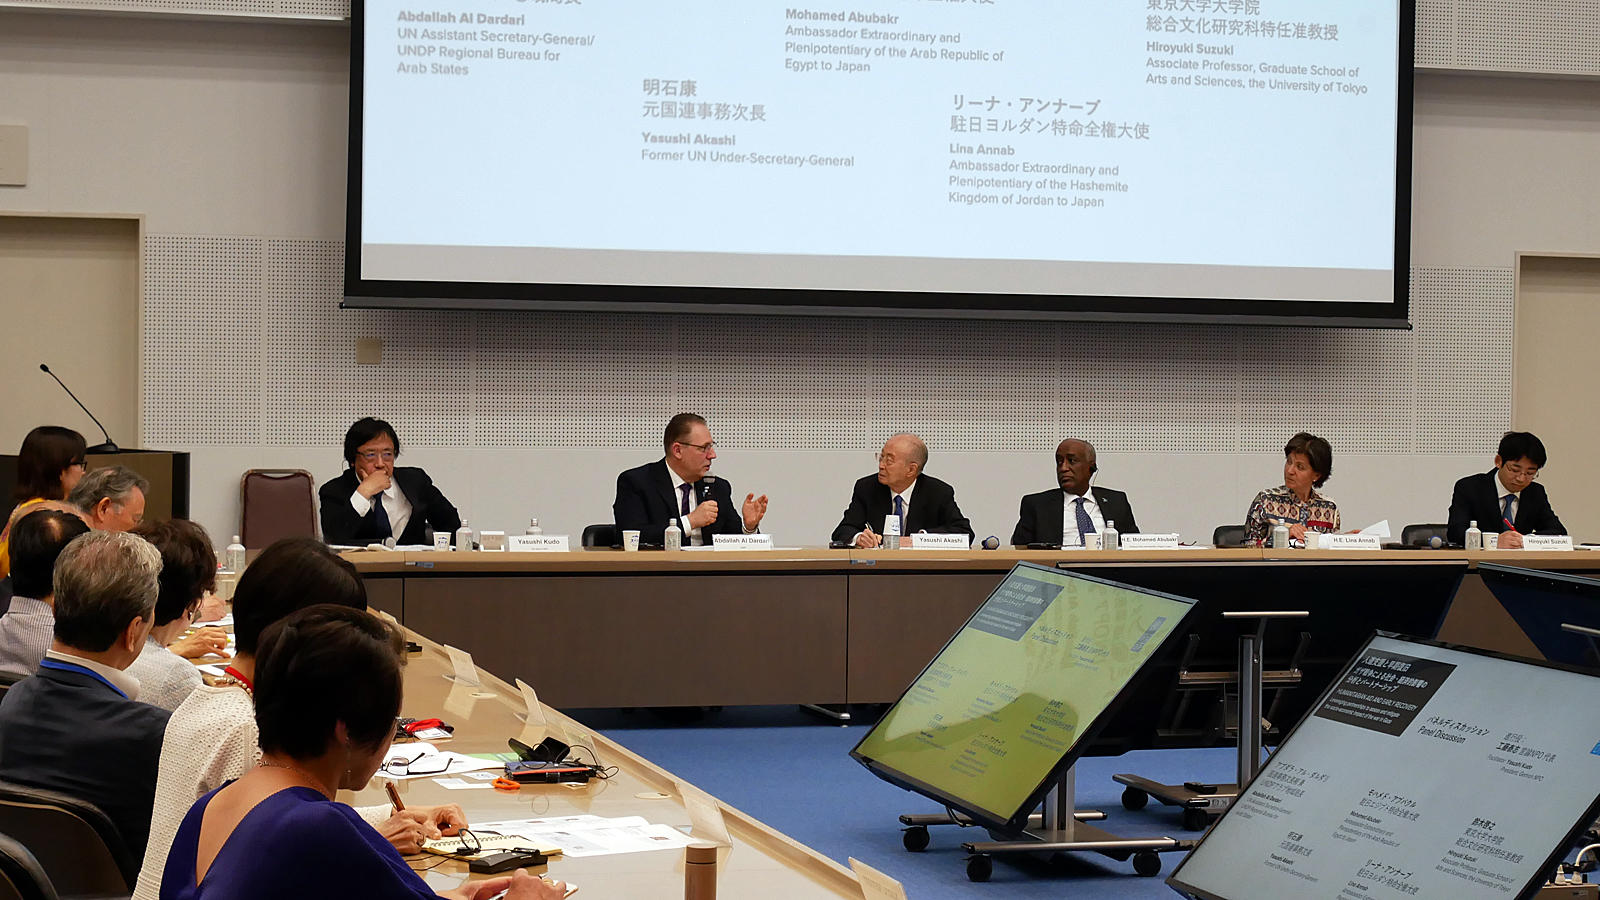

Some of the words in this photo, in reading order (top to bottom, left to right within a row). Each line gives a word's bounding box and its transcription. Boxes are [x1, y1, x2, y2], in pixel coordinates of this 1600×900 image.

[785, 8, 845, 21] Mohamed
[848, 11, 899, 24] Abubakr
[1146, 0, 1260, 16] 東京大学大学院
[397, 10, 456, 24] Abdallah
[459, 13, 473, 24] Al
[477, 13, 525, 26] Dardari
[785, 25, 858, 39] Ambassador
[860, 28, 936, 45] Extraordinary
[939, 32, 961, 44] and
[1146, 14, 1339, 41] 総合文化研究科特任准教授
[397, 28, 417, 40] UN
[421, 28, 477, 42] Assistant
[480, 30, 595, 46] Secretary-General/
[397, 45, 435, 58] UNDP
[439, 46, 494, 61] Regional
[497, 48, 541, 61] Bureau
[544, 50, 560, 61] for
[785, 42, 871, 58] Plenipotentiary
[874, 46, 886, 57] of
[888, 47, 907, 58] the
[910, 48, 937, 60] Arab
[941, 49, 989, 62] Republic
[992, 50, 1004, 61] of
[1146, 41, 1194, 55] Hiroyuki
[1197, 43, 1234, 55] Suzuki
[397, 62, 427, 75] Arab
[431, 63, 469, 76] States
[785, 58, 818, 72] Egypt
[821, 60, 832, 71] to
[835, 60, 871, 73] Japan
[1146, 57, 1199, 70] Associate
[1202, 59, 1256, 74] Professor,
[1259, 62, 1307, 75] Graduate
[1310, 64, 1346, 77] School
[1348, 66, 1360, 78] of
[643, 78, 697, 97] 明石康
[1146, 73, 1168, 85] Arts
[1170, 74, 1192, 86] and
[1194, 75, 1246, 89] Sciences,
[1248, 77, 1265, 89] the
[1269, 78, 1320, 94] University
[1323, 81, 1334, 92] of
[1336, 82, 1368, 96] Tokyo
[643, 100, 767, 122] 元国連事務次長
[950, 115, 1150, 140] 駐日ヨルダン特命全権大使
[642, 132, 691, 145] Yasushi
[694, 134, 736, 146] Akashi
[642, 149, 684, 161] Former
[688, 150, 707, 162] UN
[710, 151, 855, 168] Under-Secretary-General
[950, 143, 973, 154] Lina
[976, 144, 1015, 156] Annab
[949, 159, 1019, 173] Ambassador
[1022, 162, 1095, 177] Extraordinary
[1098, 165, 1119, 177] and
[949, 176, 1033, 192] Plenipotentiary
[1035, 178, 1047, 190] of
[1050, 179, 1067, 191] the
[1070, 180, 1128, 192] Hashemite
[949, 192, 998, 206] Kingdom
[1002, 194, 1013, 205] of
[1016, 194, 1053, 206] Jordan
[1057, 195, 1068, 206] to
[1071, 196, 1104, 209] Japan
[1417, 725, 1435, 738] Panel
[1434, 729, 1466, 745] Discussion
[1427, 716, 1490, 737] パネルディスカッション
